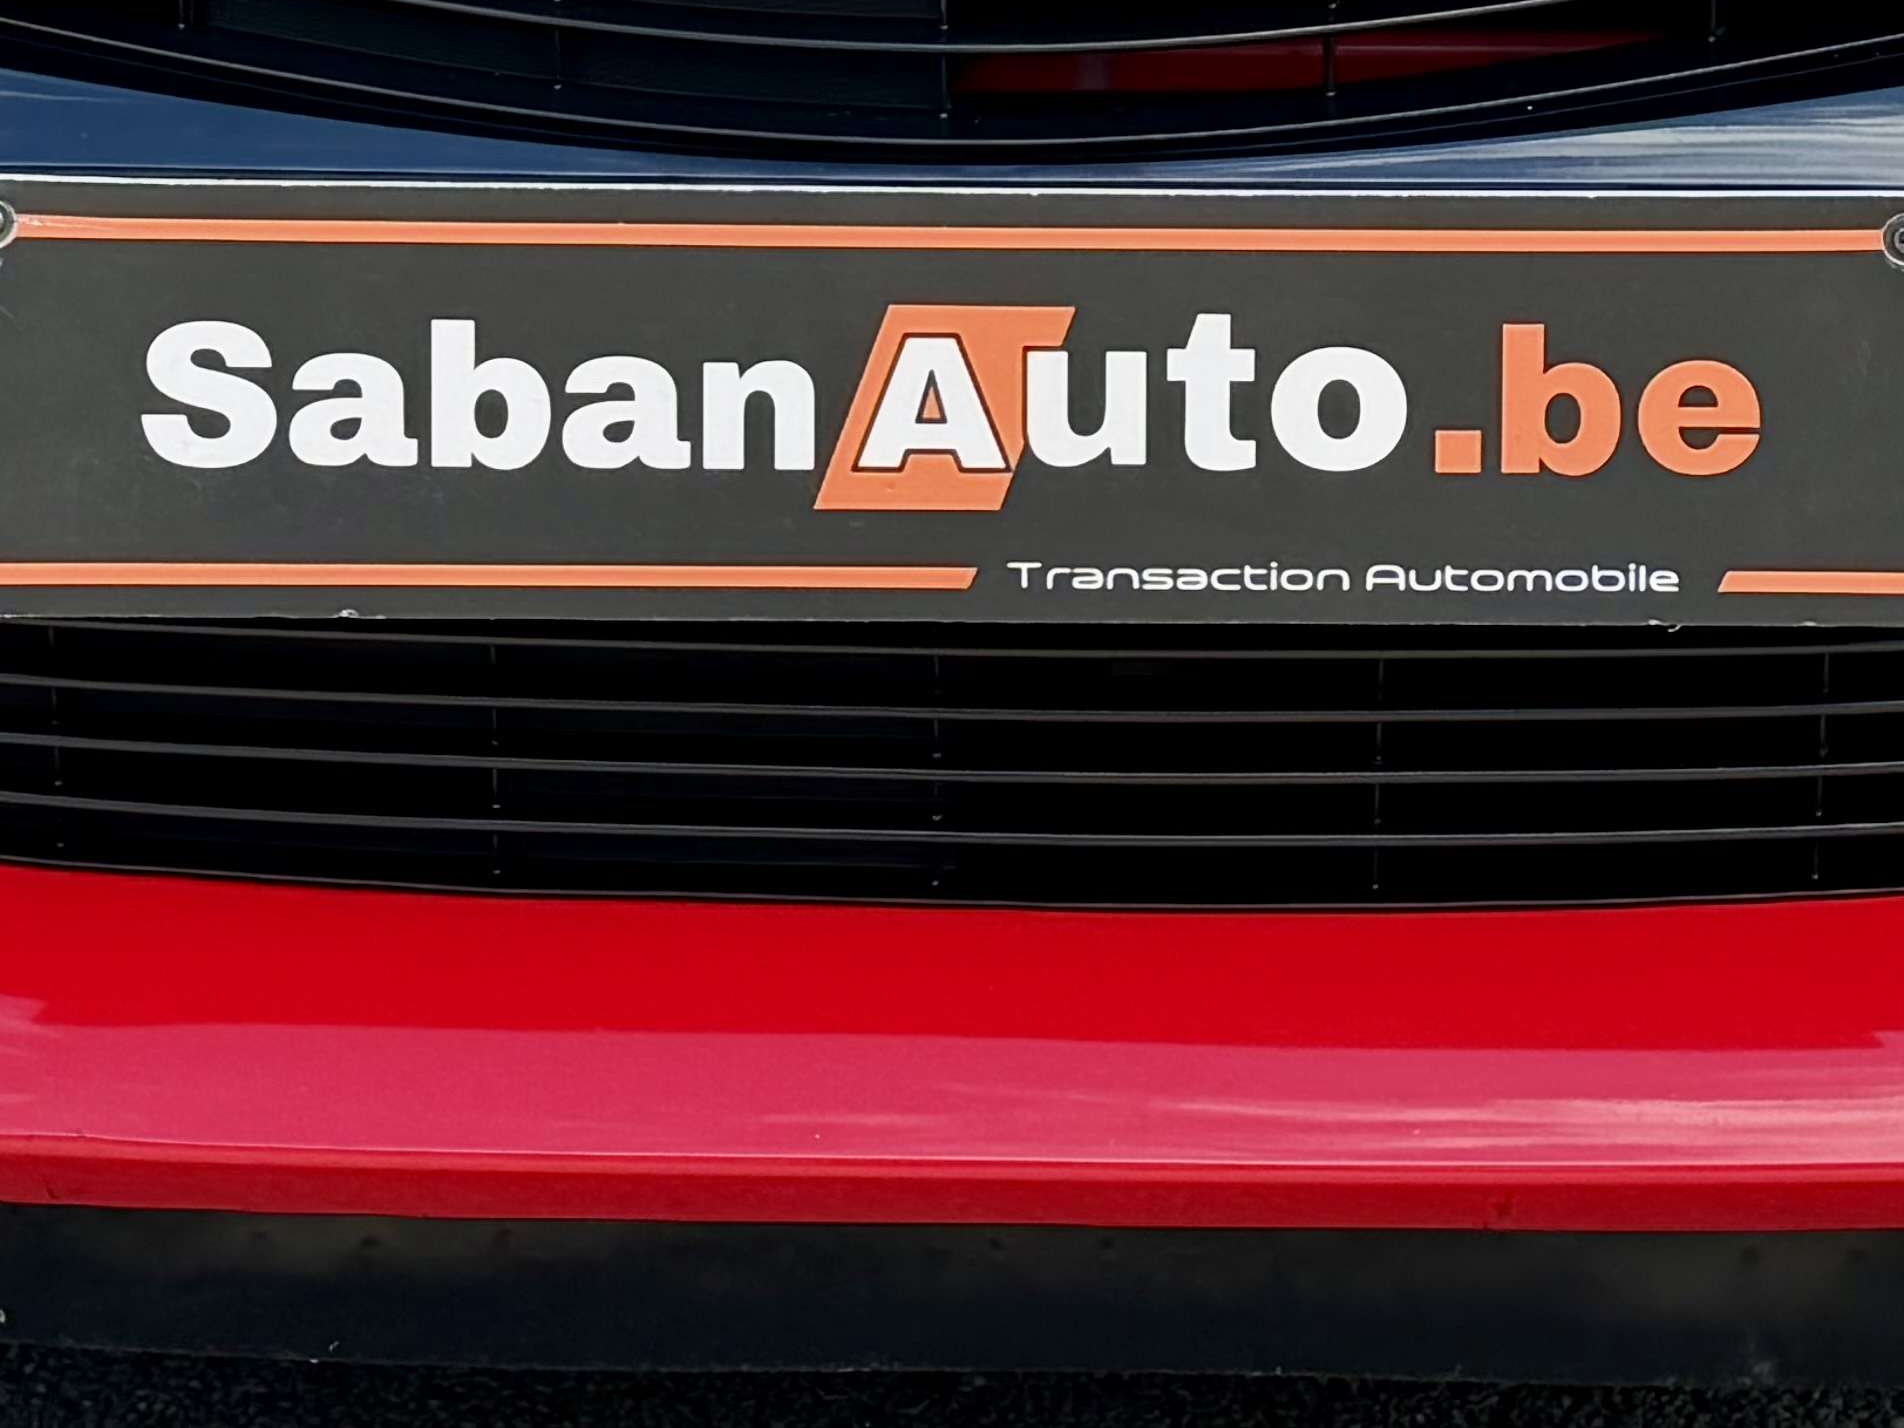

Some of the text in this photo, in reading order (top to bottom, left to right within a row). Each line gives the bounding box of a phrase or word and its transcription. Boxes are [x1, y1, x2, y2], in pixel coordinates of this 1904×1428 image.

[140, 311, 1763, 477] SabanAuto.be
[1006, 560, 1681, 594] Transaction Automobile
